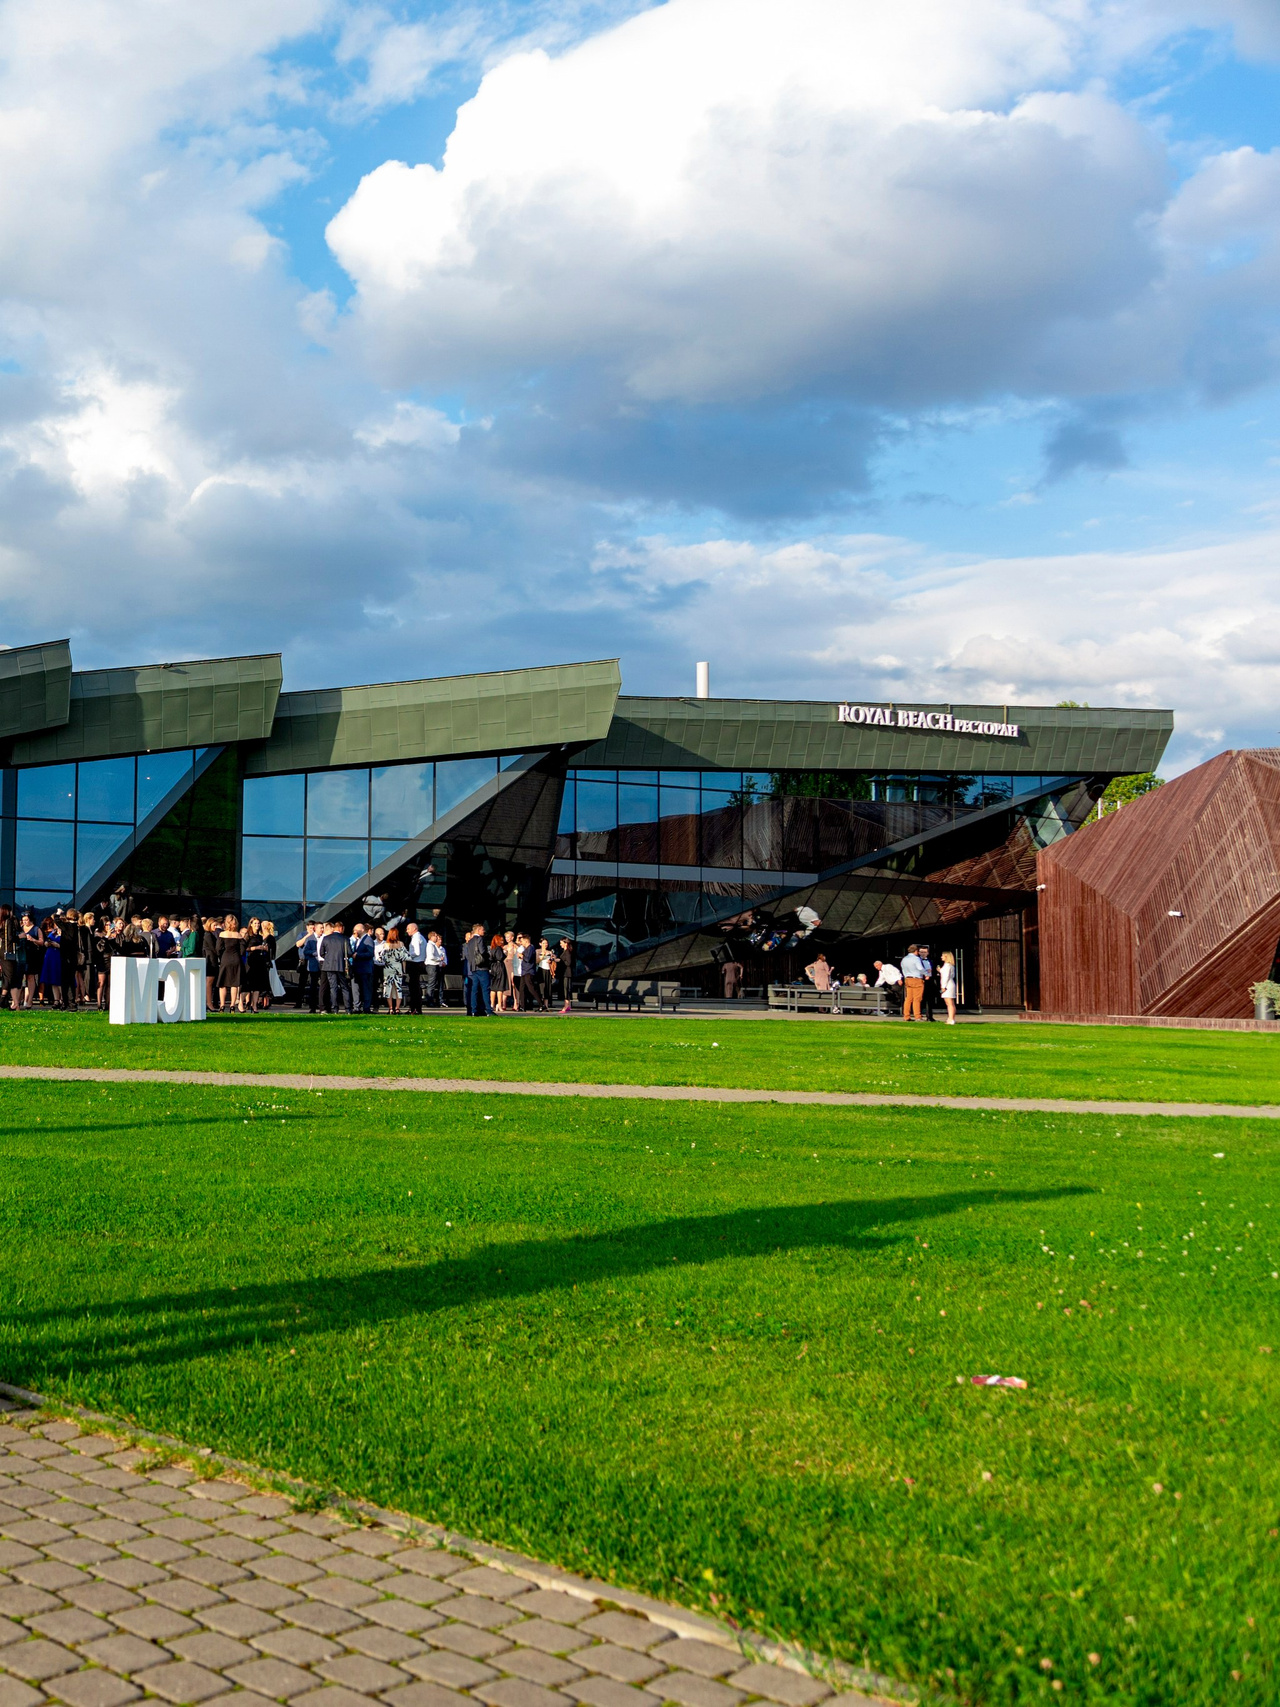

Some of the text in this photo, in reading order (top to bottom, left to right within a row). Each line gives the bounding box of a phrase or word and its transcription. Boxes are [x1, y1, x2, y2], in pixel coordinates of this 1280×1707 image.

[838, 704, 1019, 737] ROYAL BEACH РЕСТОРАН
